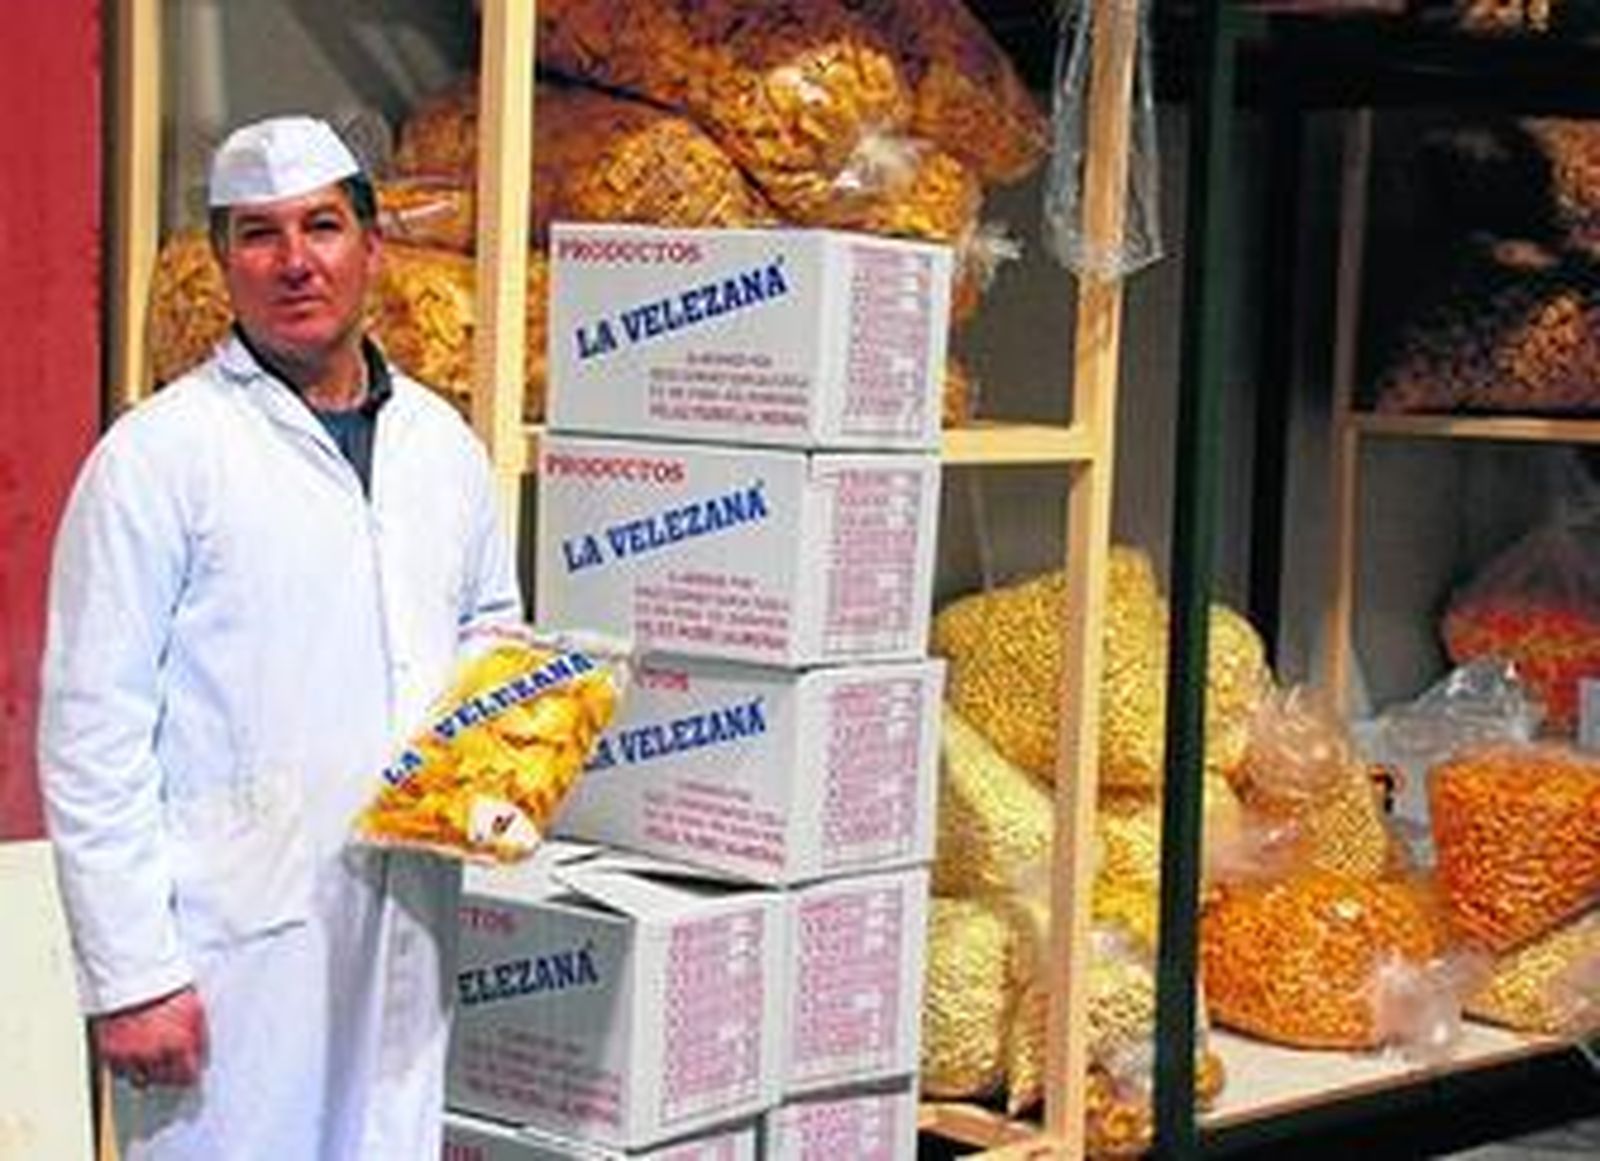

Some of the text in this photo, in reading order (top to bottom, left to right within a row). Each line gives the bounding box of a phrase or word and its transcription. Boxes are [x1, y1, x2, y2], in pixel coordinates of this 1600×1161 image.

[576, 319, 617, 358] LA
[563, 534, 603, 573] LA
[383, 751, 422, 785] LA
[457, 948, 599, 1006] ELEZANA
